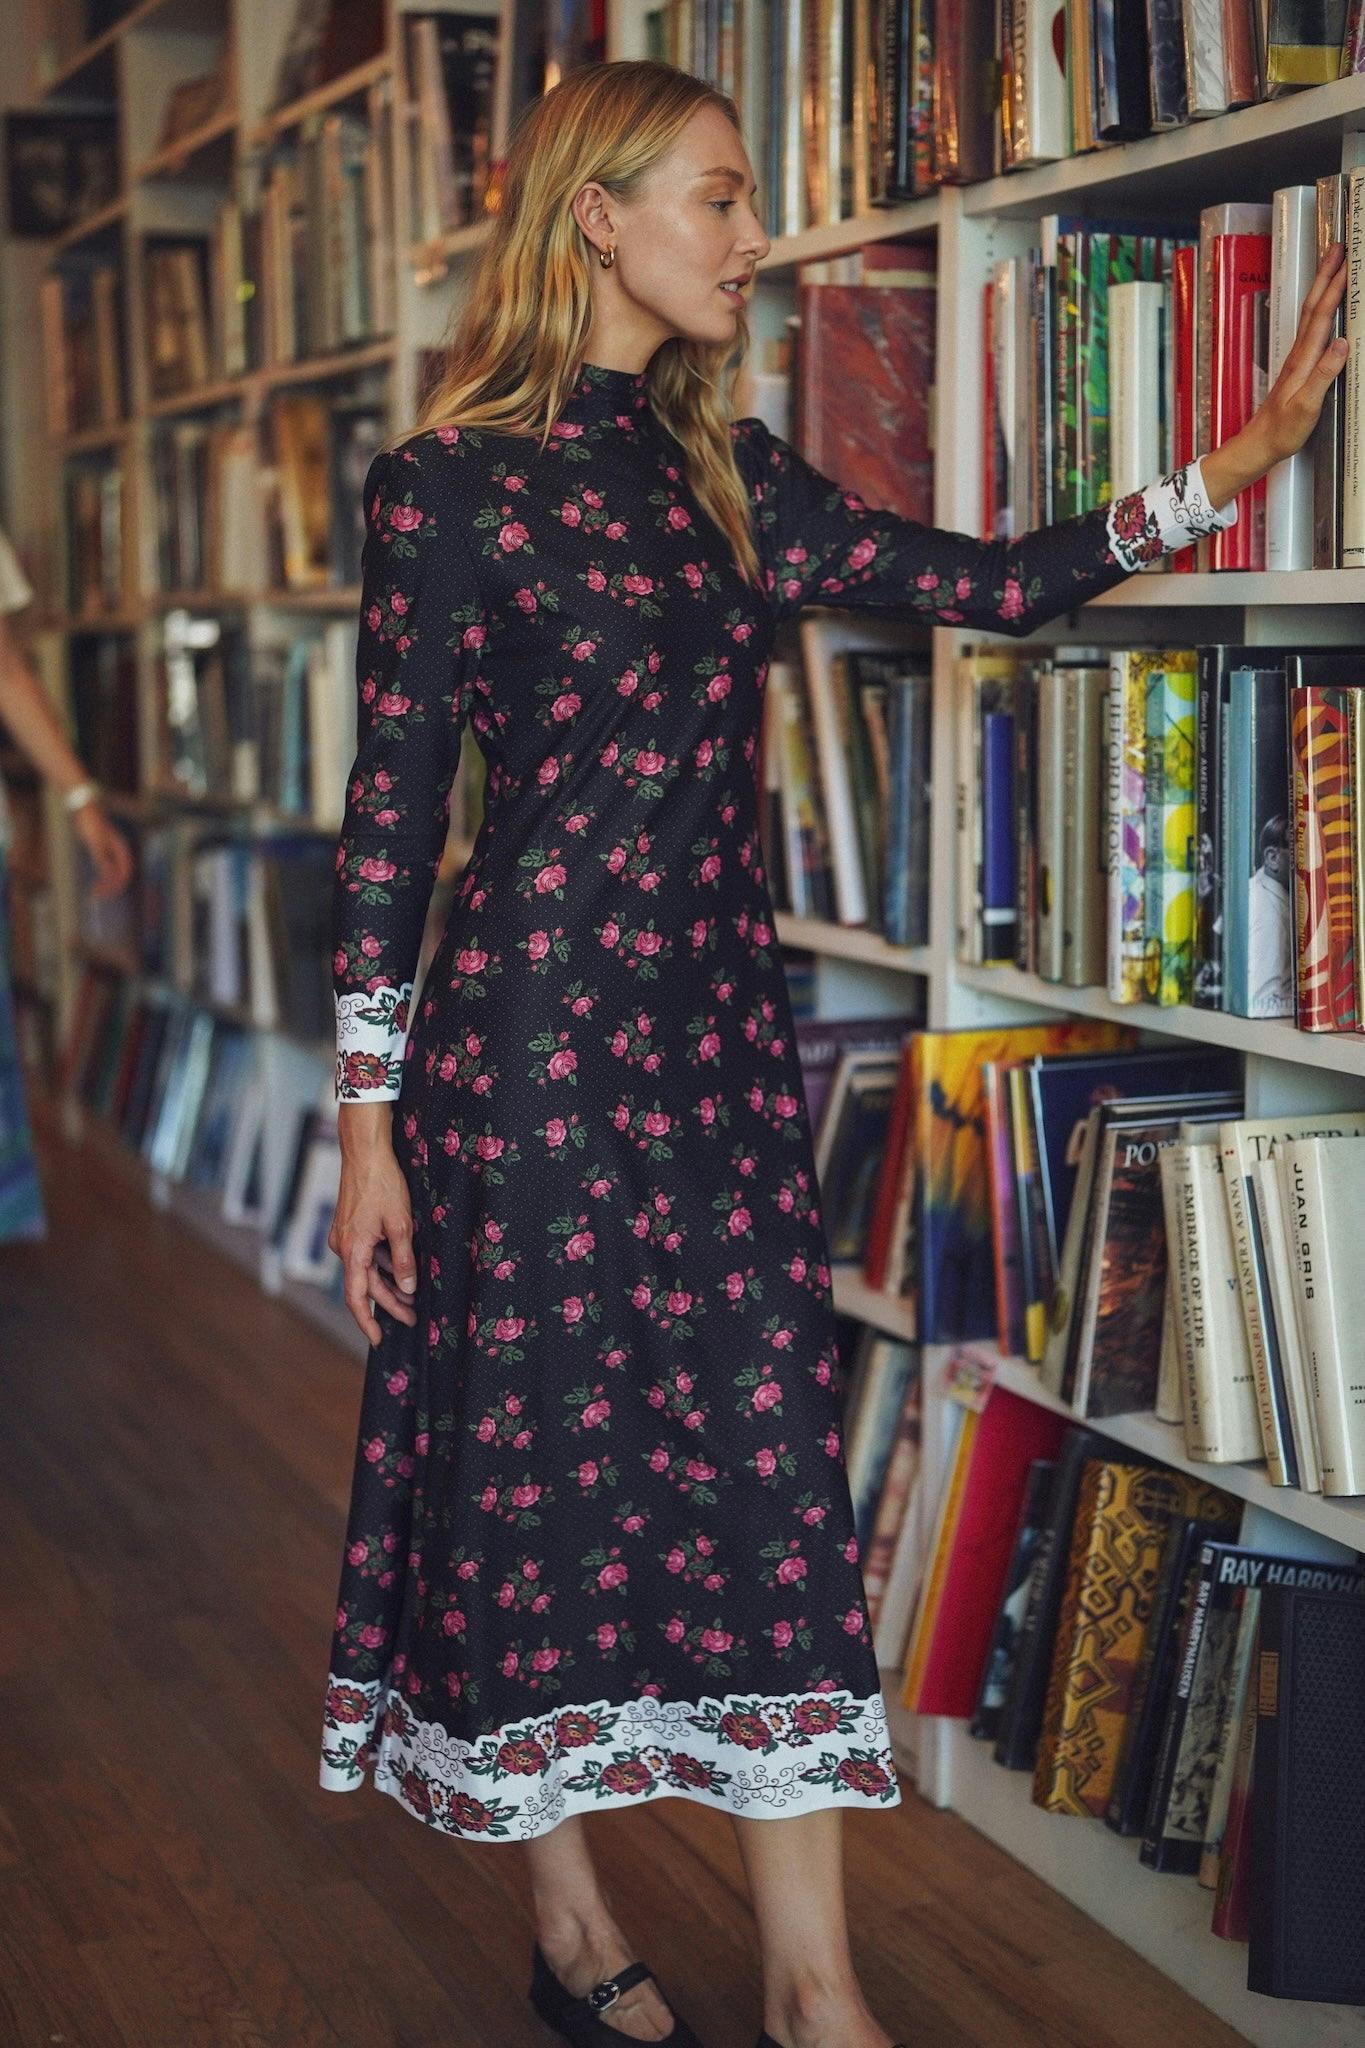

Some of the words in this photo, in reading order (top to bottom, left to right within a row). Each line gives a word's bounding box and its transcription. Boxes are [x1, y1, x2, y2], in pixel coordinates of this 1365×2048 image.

[1352, 177, 1365, 218] People
[1352, 237, 1362, 256] the
[1353, 222, 1363, 234] of
[1351, 259, 1362, 287] First
[1350, 290, 1361, 320] Man
[1108, 667, 1122, 801] CLIFFORD
[1199, 757, 1208, 814] AMERICA
[1109, 812, 1121, 877] ROSS
[1297, 826, 1306, 871] ROGERS
[1230, 1178, 1245, 1229] ASANA
[1184, 1183, 1201, 1271] EMBRACE
[1294, 1163, 1308, 1229] JUAN
[1301, 1242, 1315, 1300] GRIS
[1190, 1277, 1202, 1300] OF
[1238, 1236, 1254, 1298] TANTRA
[1193, 1306, 1205, 1348] LIFE
[1219, 1556, 1264, 1585] RAY
[1197, 1580, 1211, 1607] RAY
[1177, 1607, 1205, 1698] HARRYHAUSEN
